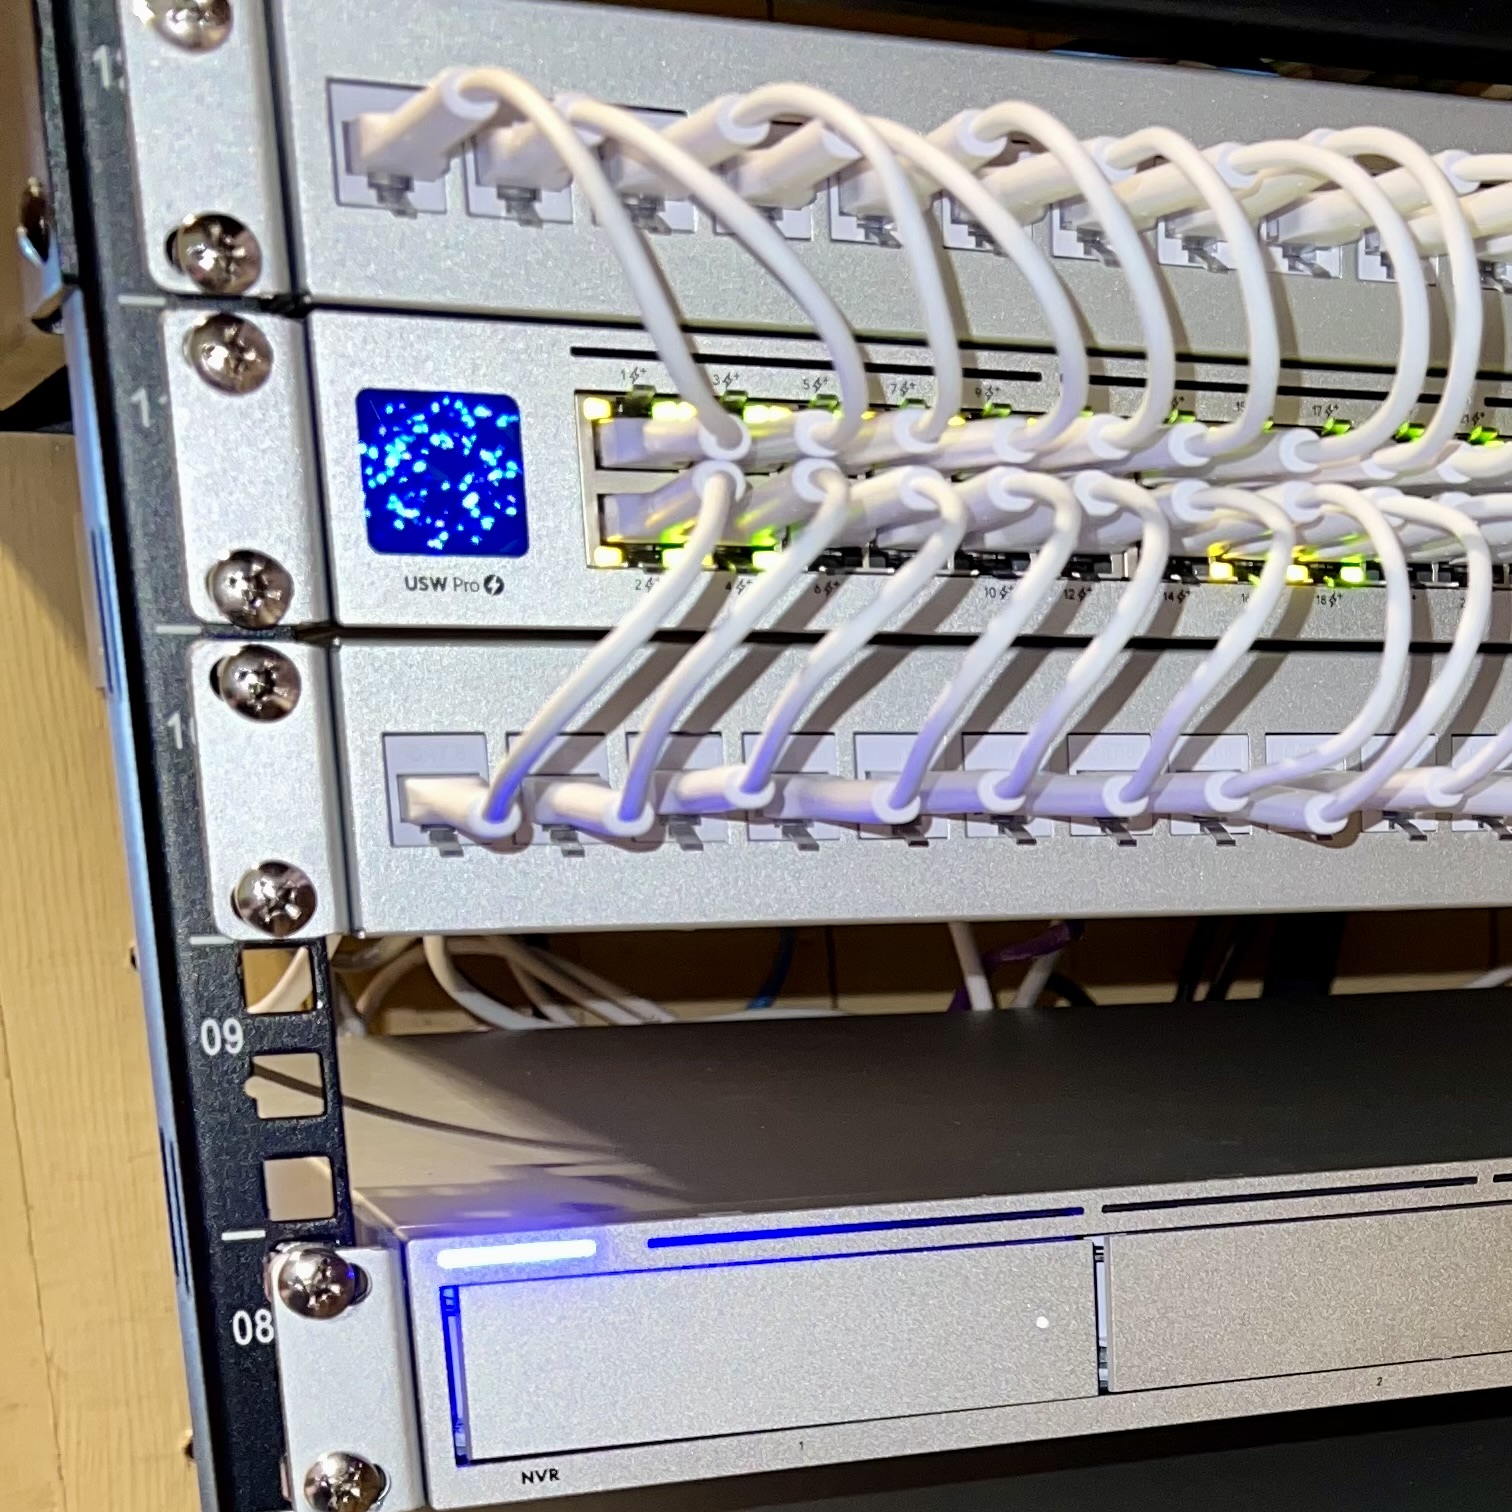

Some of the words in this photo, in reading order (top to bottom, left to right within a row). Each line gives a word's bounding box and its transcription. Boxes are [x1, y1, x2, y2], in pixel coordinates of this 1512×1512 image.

[404, 575, 448, 592] USW
[453, 576, 480, 593] Pro
[200, 1017, 244, 1056] 09
[232, 1308, 275, 1347] 08
[521, 1468, 561, 1485] NVR
